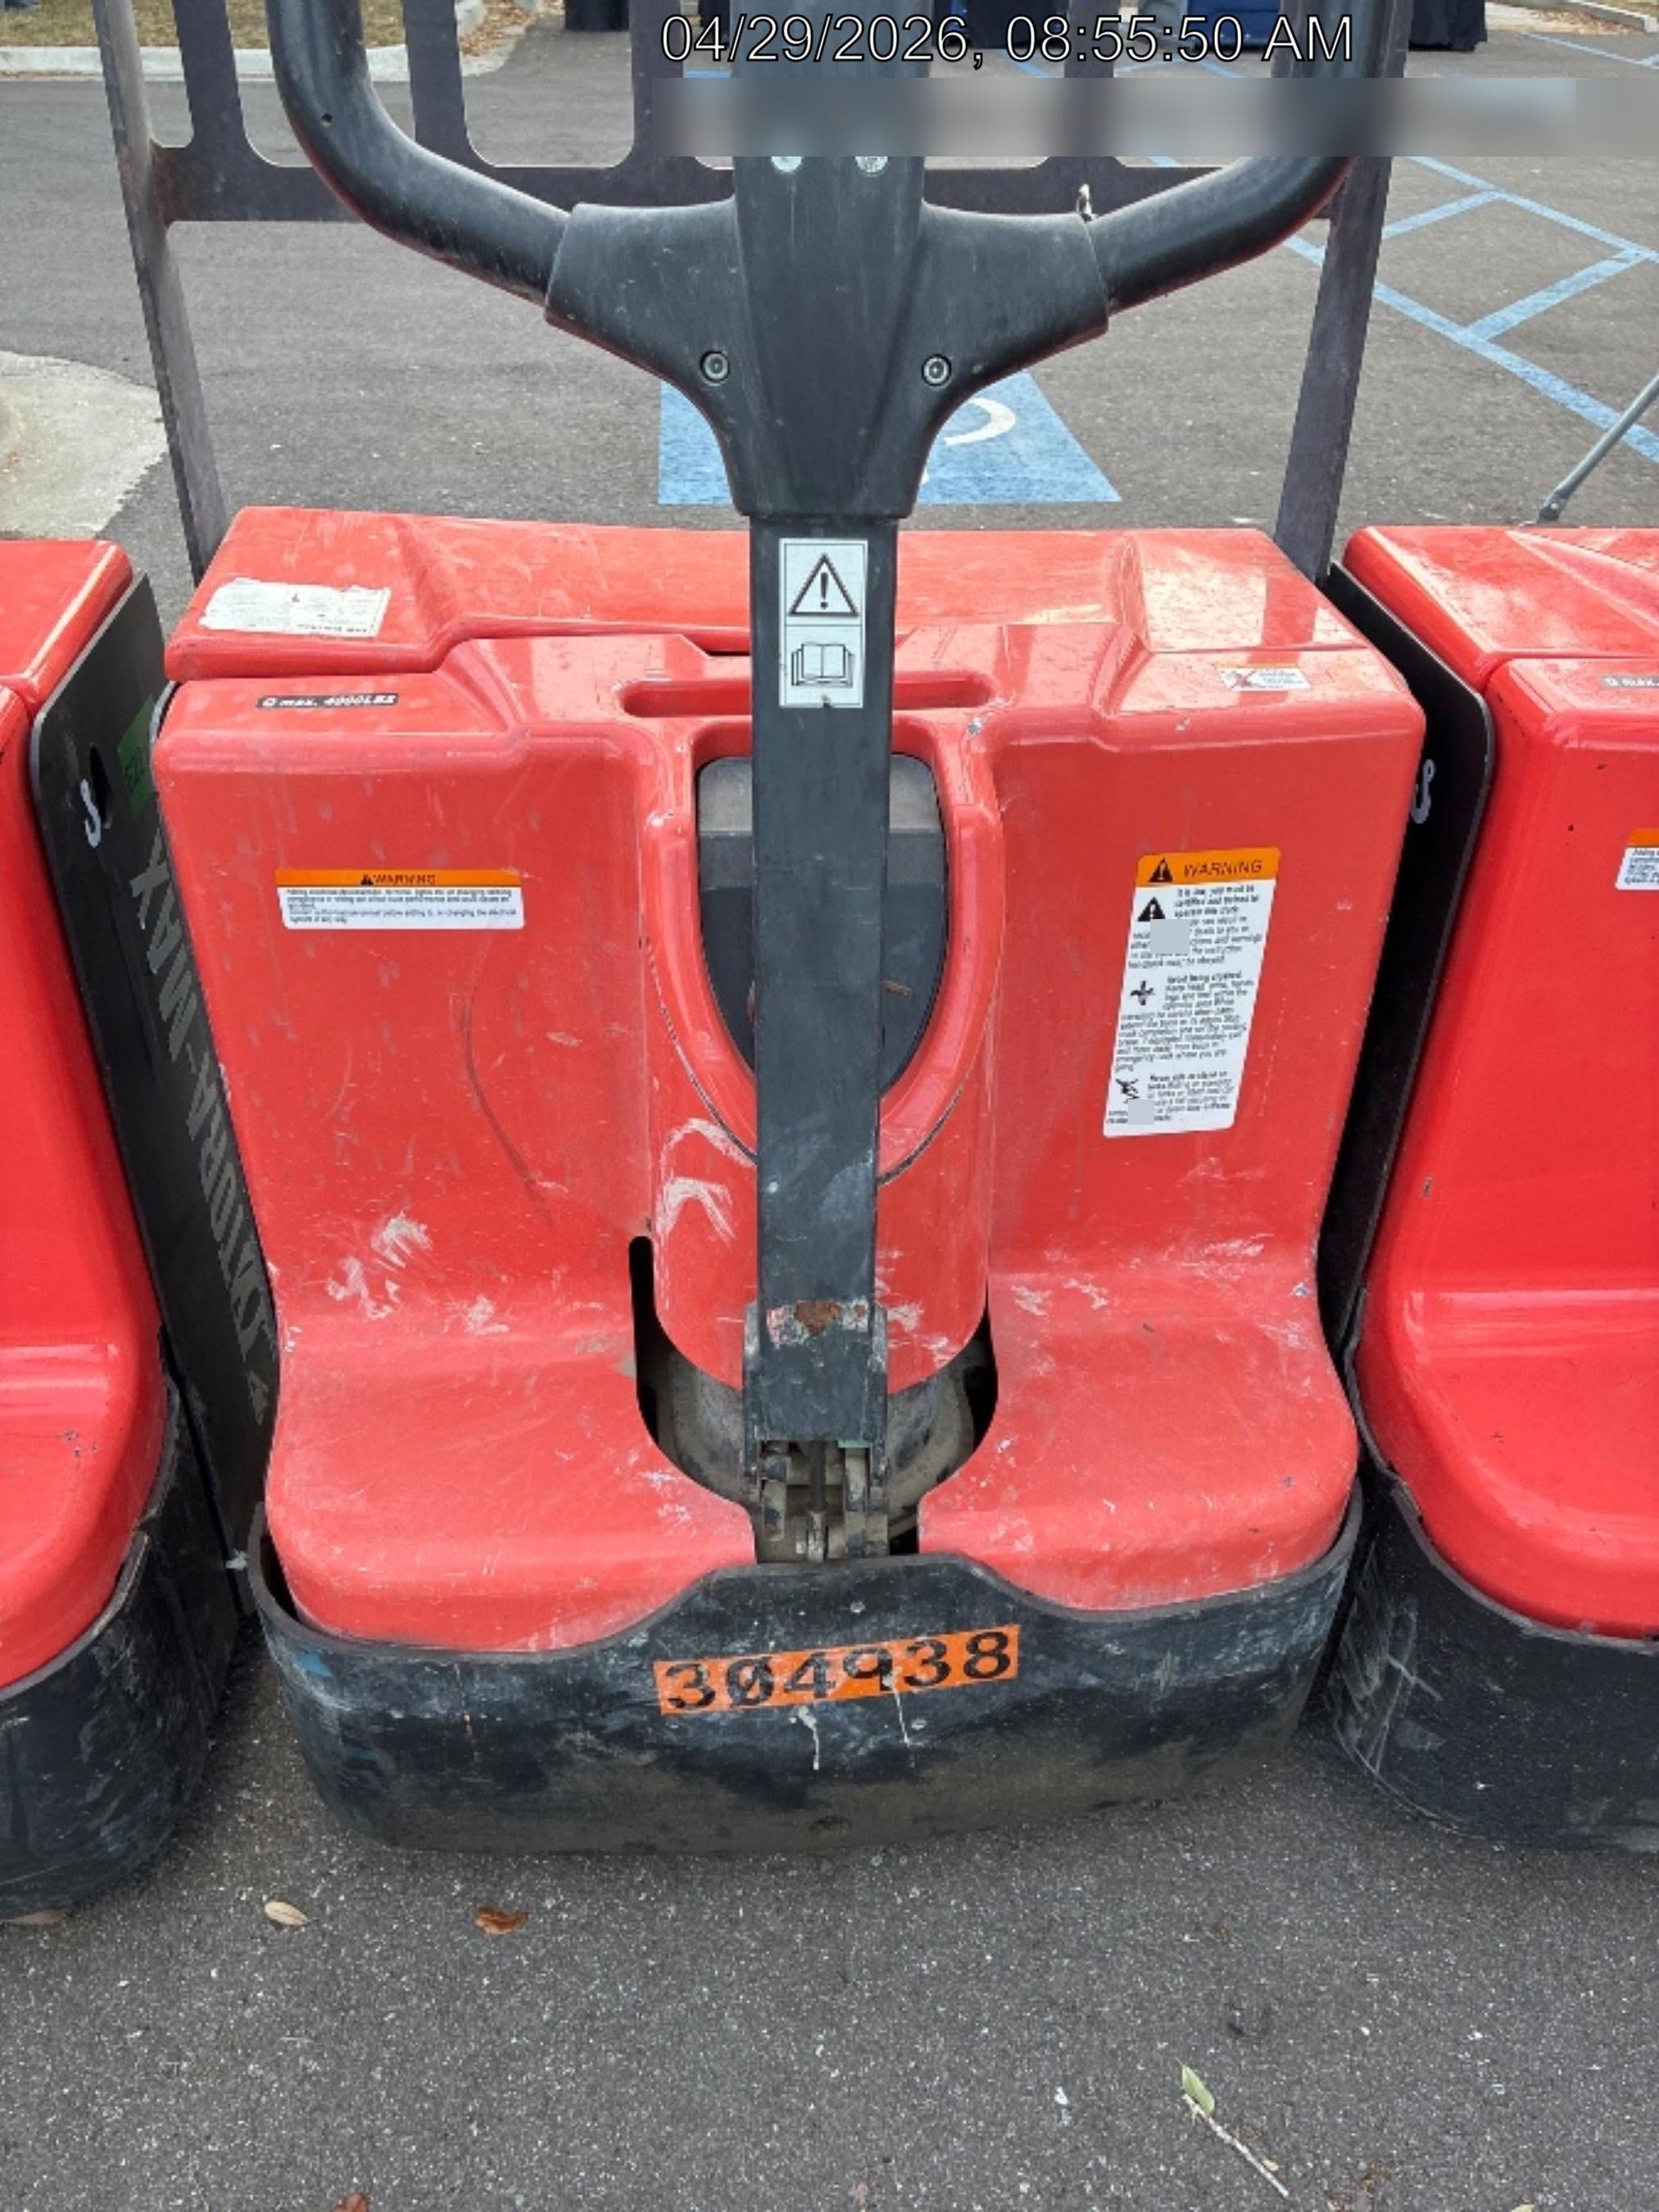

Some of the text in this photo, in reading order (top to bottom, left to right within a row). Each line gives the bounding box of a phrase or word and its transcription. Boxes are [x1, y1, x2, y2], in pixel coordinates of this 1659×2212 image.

[1184, 859, 1262, 877] WARNING
[374, 874, 436, 884] WARNING
[664, 1630, 1012, 1710] 304938
